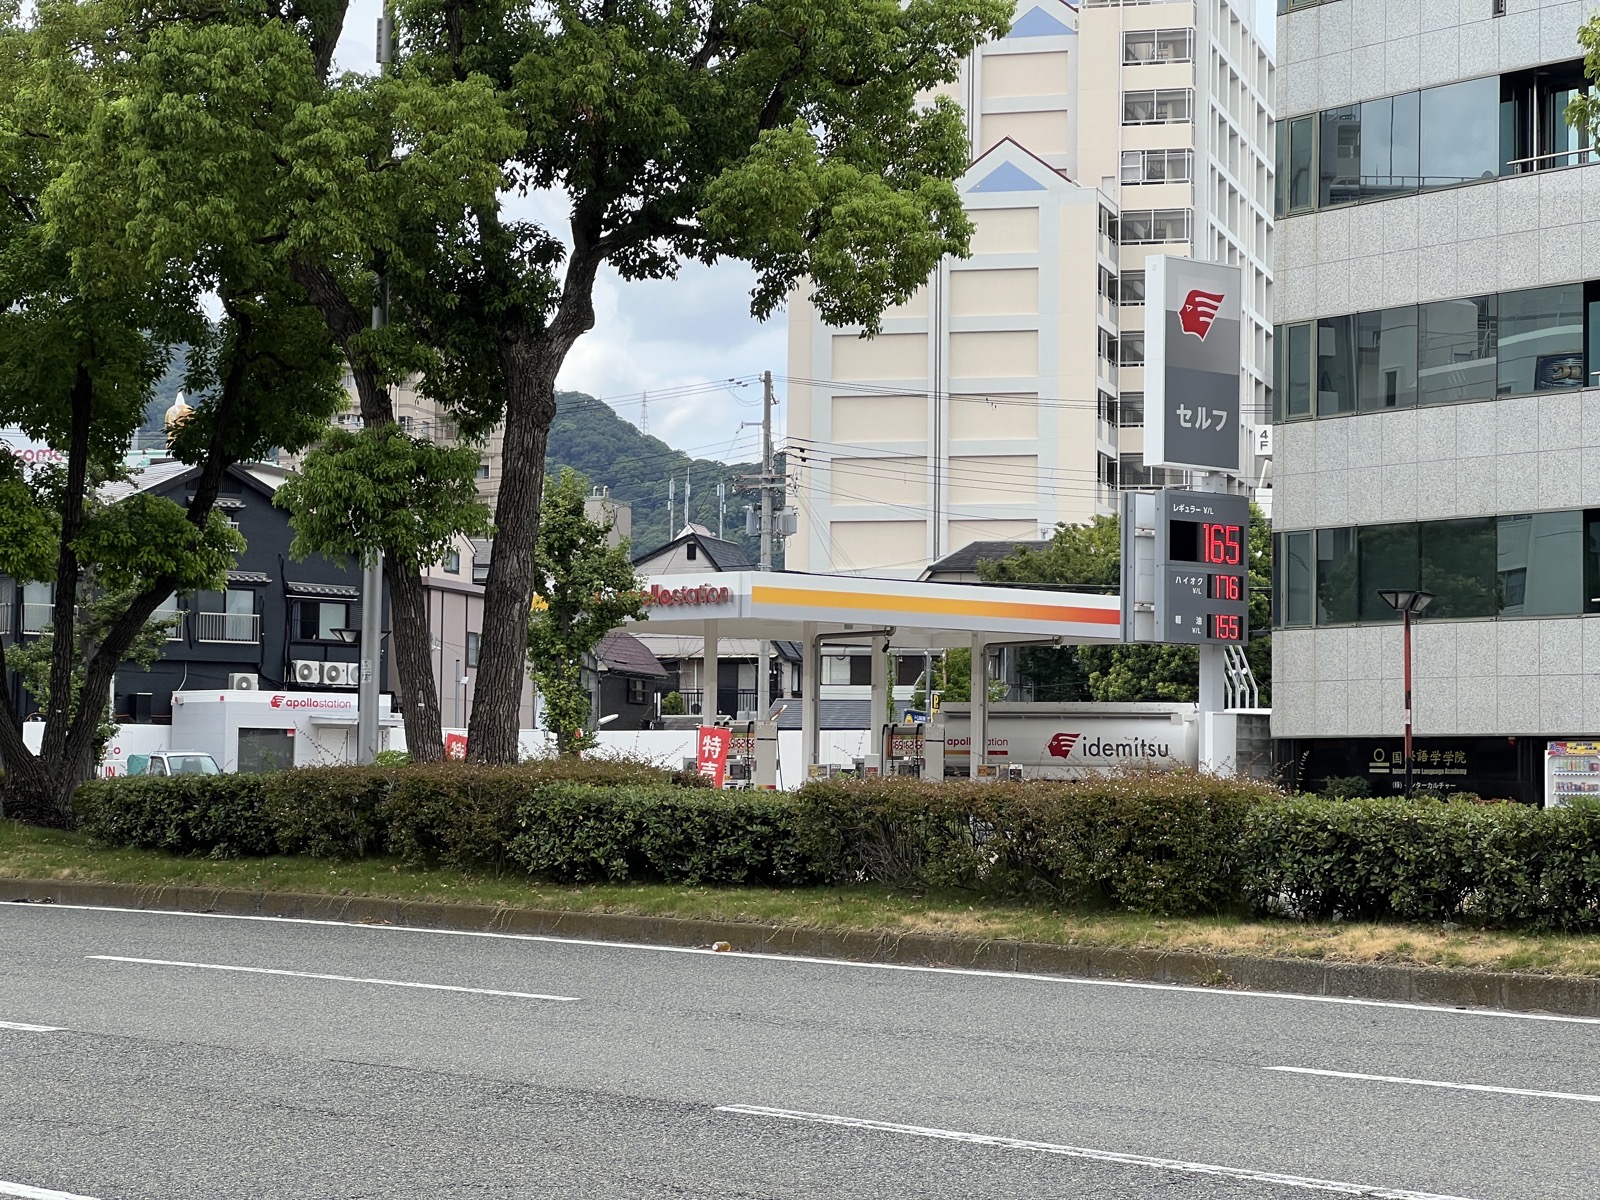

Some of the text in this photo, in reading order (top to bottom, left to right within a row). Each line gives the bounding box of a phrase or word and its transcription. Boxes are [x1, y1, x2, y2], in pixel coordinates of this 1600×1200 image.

[1176, 403, 1228, 432] セルフ
[1173, 503, 1202, 514] レギュラー
[1203, 522, 1240, 565] 165
[1175, 576, 1203, 585] ハイオク
[1215, 575, 1239, 600] 176
[1215, 615, 1239, 640] 155
[285, 697, 352, 710] apollostation
[947, 736, 1009, 748] apollation
[1082, 736, 1169, 758] idemitsu
[105, 765, 116, 778] IN
